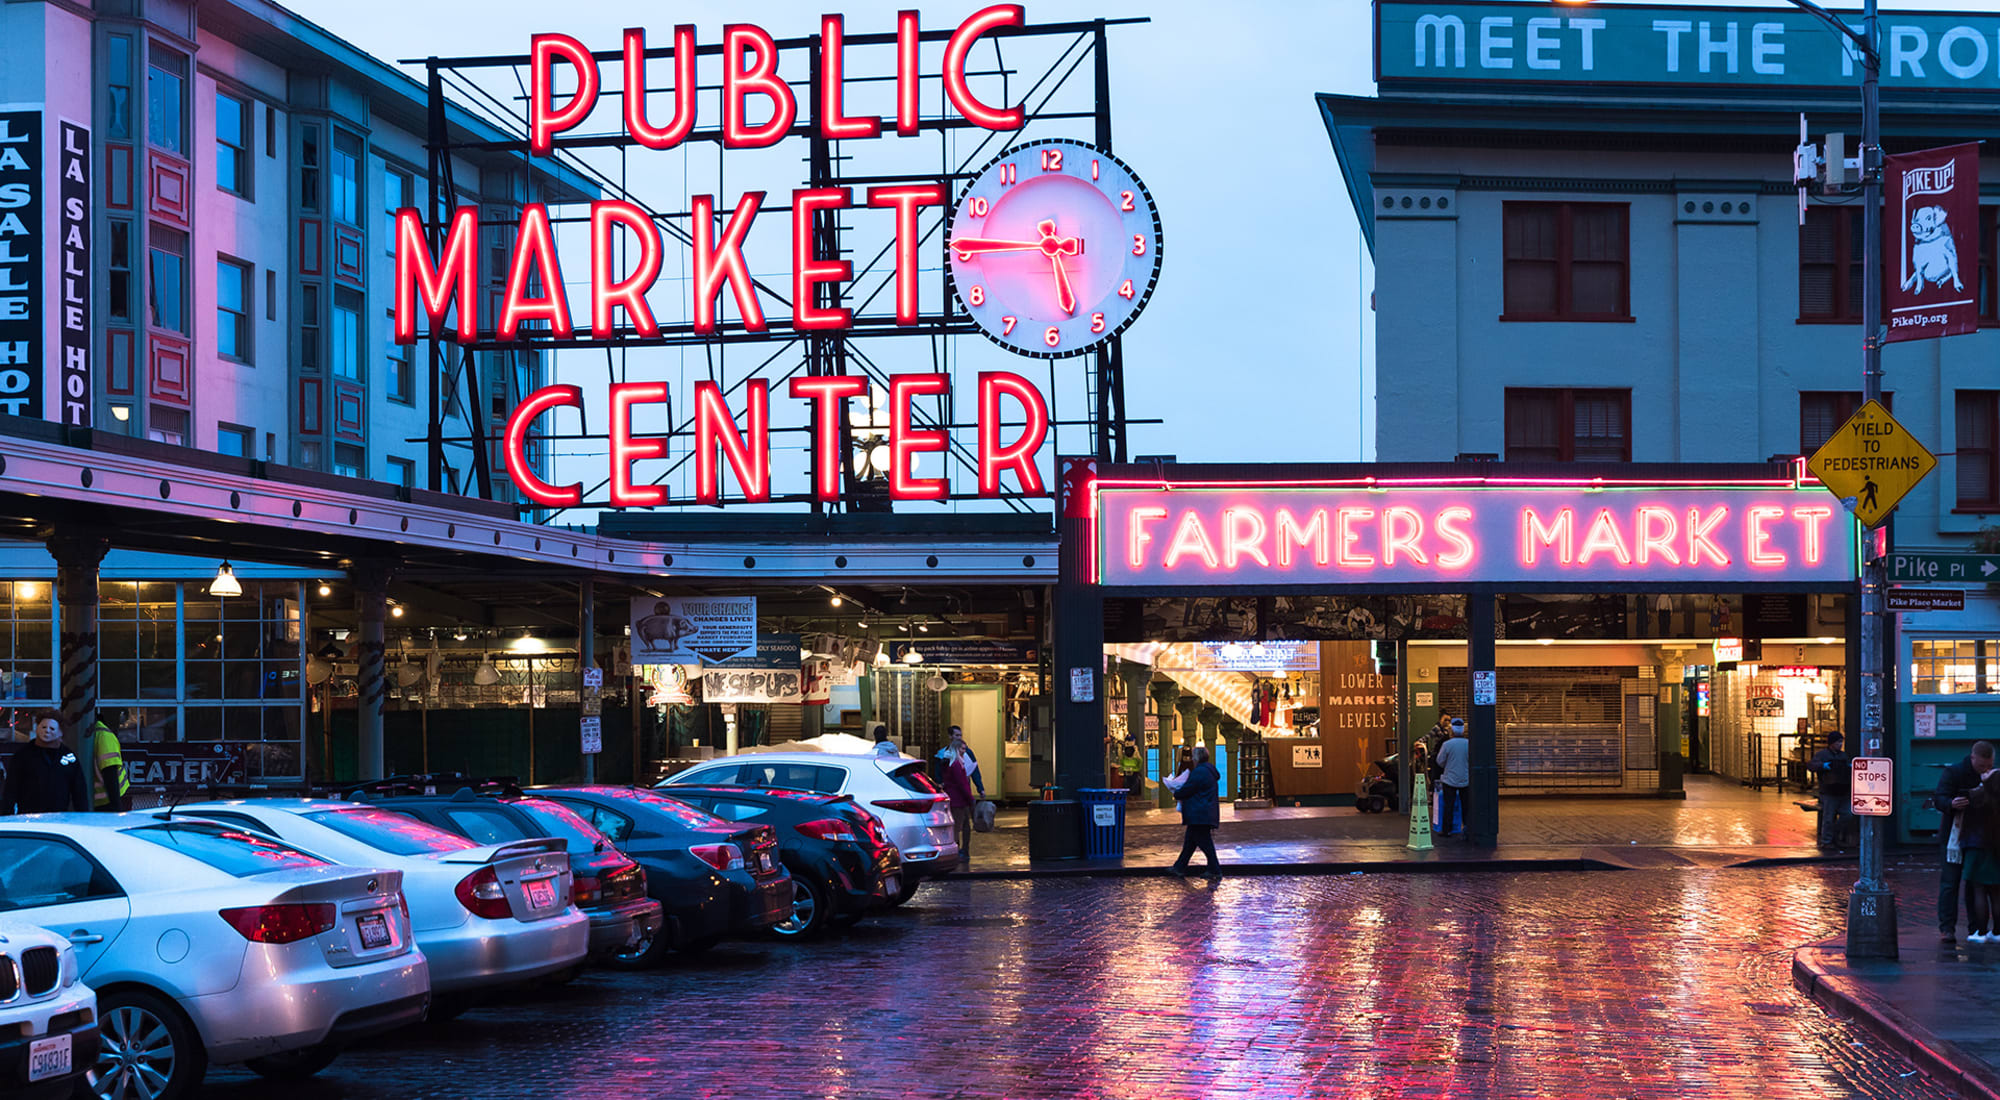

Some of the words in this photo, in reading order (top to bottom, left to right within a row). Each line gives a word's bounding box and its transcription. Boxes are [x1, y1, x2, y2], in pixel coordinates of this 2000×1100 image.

[1414, 13, 1606, 71] MEET
[1652, 19, 1785, 75] THE
[1841, 24, 2000, 80] PRO
[531, 4, 1025, 157] PUBLIC
[0, 119, 31, 171] LA
[64, 127, 85, 184] LA
[1041, 149, 1064, 171] 12
[1091, 160, 1099, 181] 1
[999, 163, 1017, 185] 11
[1904, 170, 1931, 197] PIKE
[1934, 163, 1955, 189] UP!
[968, 196, 989, 218] 10
[1120, 190, 1135, 212] 2
[0, 183, 31, 321] SALLE
[1132, 233, 1147, 256] 3
[64, 197, 85, 332] SALLE
[394, 182, 948, 346] MARKET
[969, 284, 986, 307] 8
[1117, 278, 1136, 300] 4
[1001, 315, 1018, 337] 7
[1090, 312, 1106, 334] 5
[1891, 313, 1948, 328] PikeUp.org
[1044, 325, 1060, 347] 6
[0, 340, 31, 417] HOT
[65, 345, 86, 426] HOT
[501, 370, 1050, 507] CENTER
[1851, 422, 1894, 436] YIELD
[1863, 439, 1880, 453] TO
[1823, 456, 1920, 472] PEDESTRIANS
[1128, 505, 1475, 568] FARMERS
[1520, 505, 1833, 567] MARKET
[1894, 556, 1939, 577] Pike
[1950, 563, 1965, 577] Pl
[681, 602, 711, 616] YOUR
[711, 602, 753, 616] CHANGE
[1889, 598, 1908, 606] Pike
[1909, 598, 1931, 607] Place
[1932, 599, 1962, 608] Market
[766, 672, 799, 698] UPS
[1340, 673, 1384, 689] LOWER
[1328, 695, 1394, 706] MARKET
[1339, 712, 1387, 729] LEVELS
[1854, 761, 1867, 769] NO
[1857, 772, 1887, 781] STOPS
